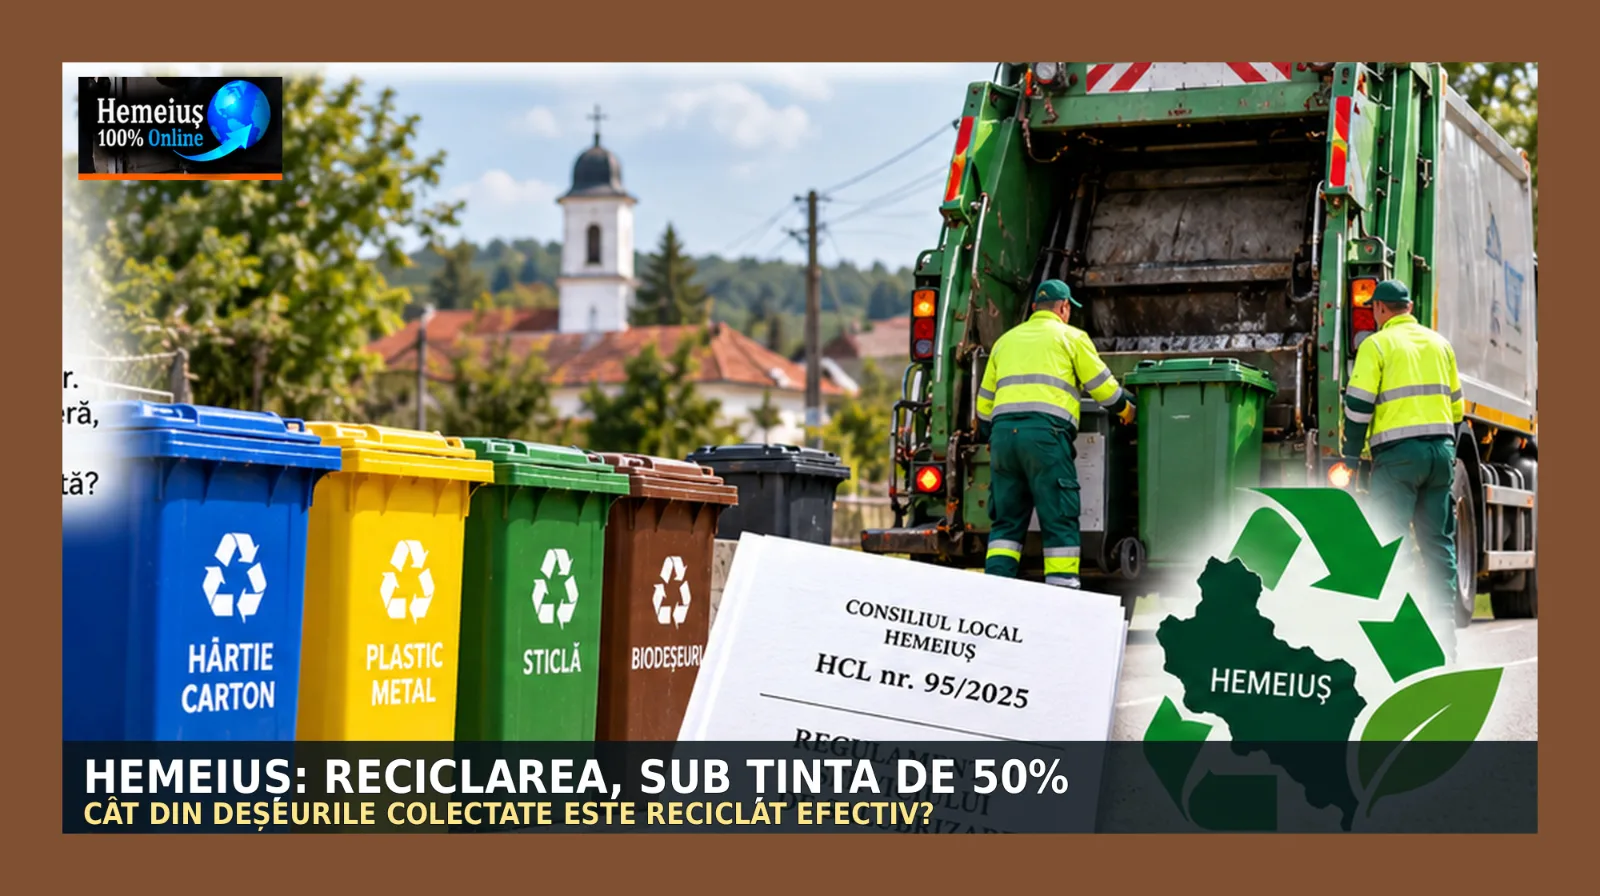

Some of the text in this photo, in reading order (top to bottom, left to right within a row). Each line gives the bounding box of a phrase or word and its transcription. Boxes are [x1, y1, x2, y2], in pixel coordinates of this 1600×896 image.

[846, 599, 1023, 643] CONSILIUL LOCAL
[366, 642, 443, 671] PLASTIC
[523, 642, 581, 675] STICLĂ
[181, 681, 275, 714] CARTON
[371, 677, 436, 706] METAL
[815, 653, 1030, 709] HCL nr. 95/2025
